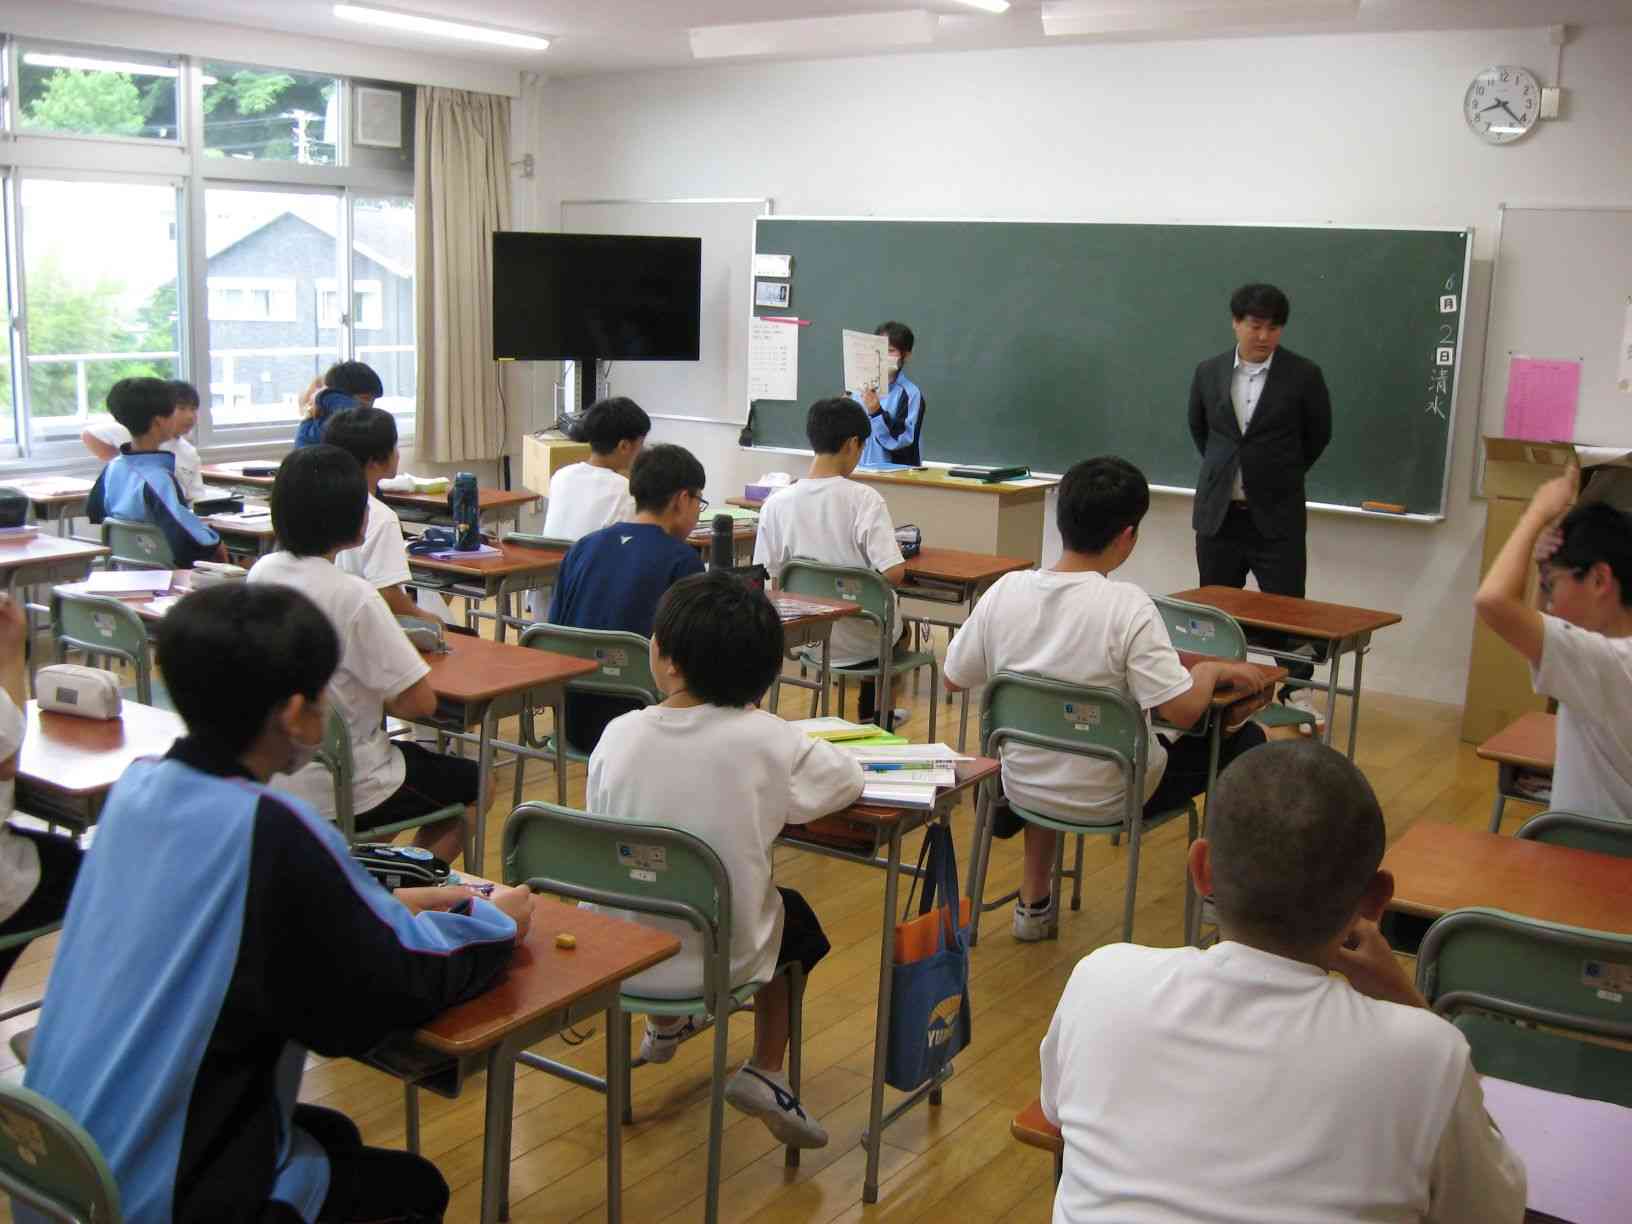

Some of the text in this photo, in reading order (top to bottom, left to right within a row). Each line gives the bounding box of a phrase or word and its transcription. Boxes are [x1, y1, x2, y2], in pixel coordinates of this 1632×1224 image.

[1500, 71, 1510, 81] 12
[1475, 86, 1485, 96] 10
[1523, 85, 1530, 96] 2
[1526, 99, 1532, 109] 3
